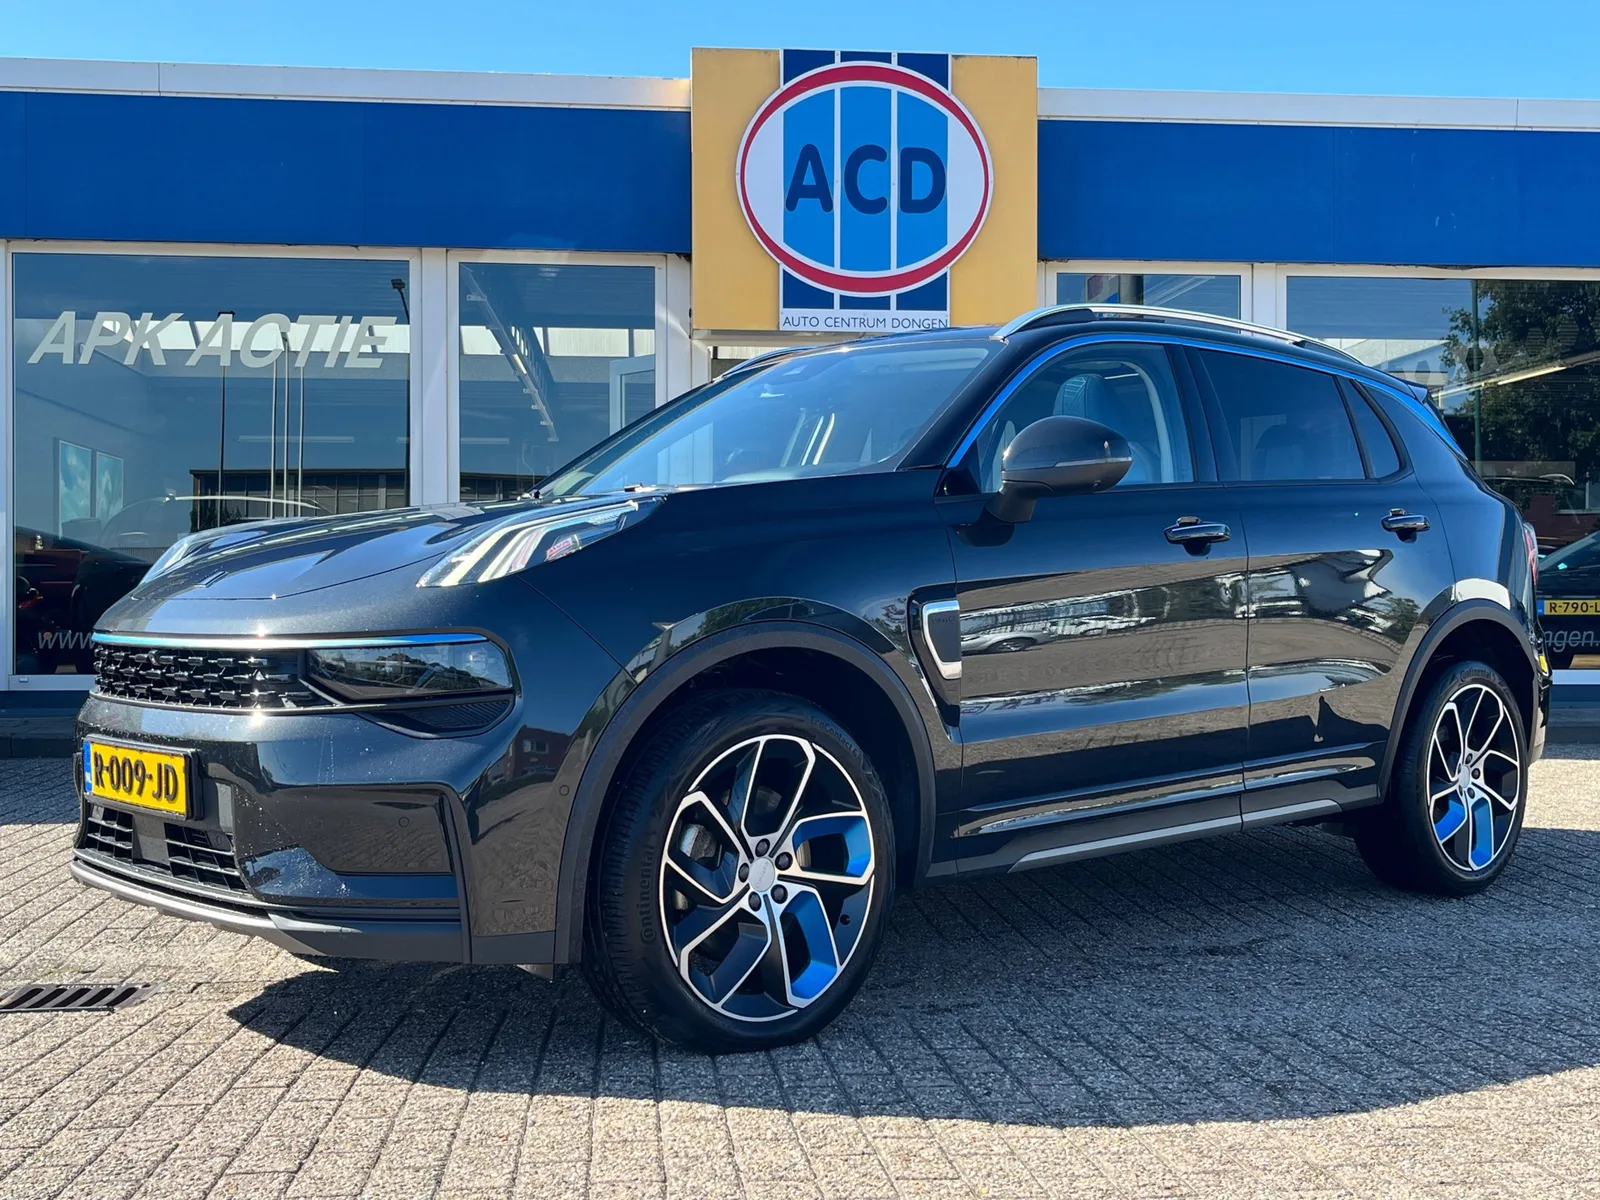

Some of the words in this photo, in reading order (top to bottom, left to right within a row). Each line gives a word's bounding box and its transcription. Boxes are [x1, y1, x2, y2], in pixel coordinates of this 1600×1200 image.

[785, 143, 947, 215] ACD
[27, 311, 184, 366] APK
[185, 312, 397, 369] ACTIE
[782, 316, 820, 328] AUTO
[824, 316, 886, 329] CENTRUM
[891, 317, 948, 330] DONGEN
[94, 751, 179, 802] R-009-JD
